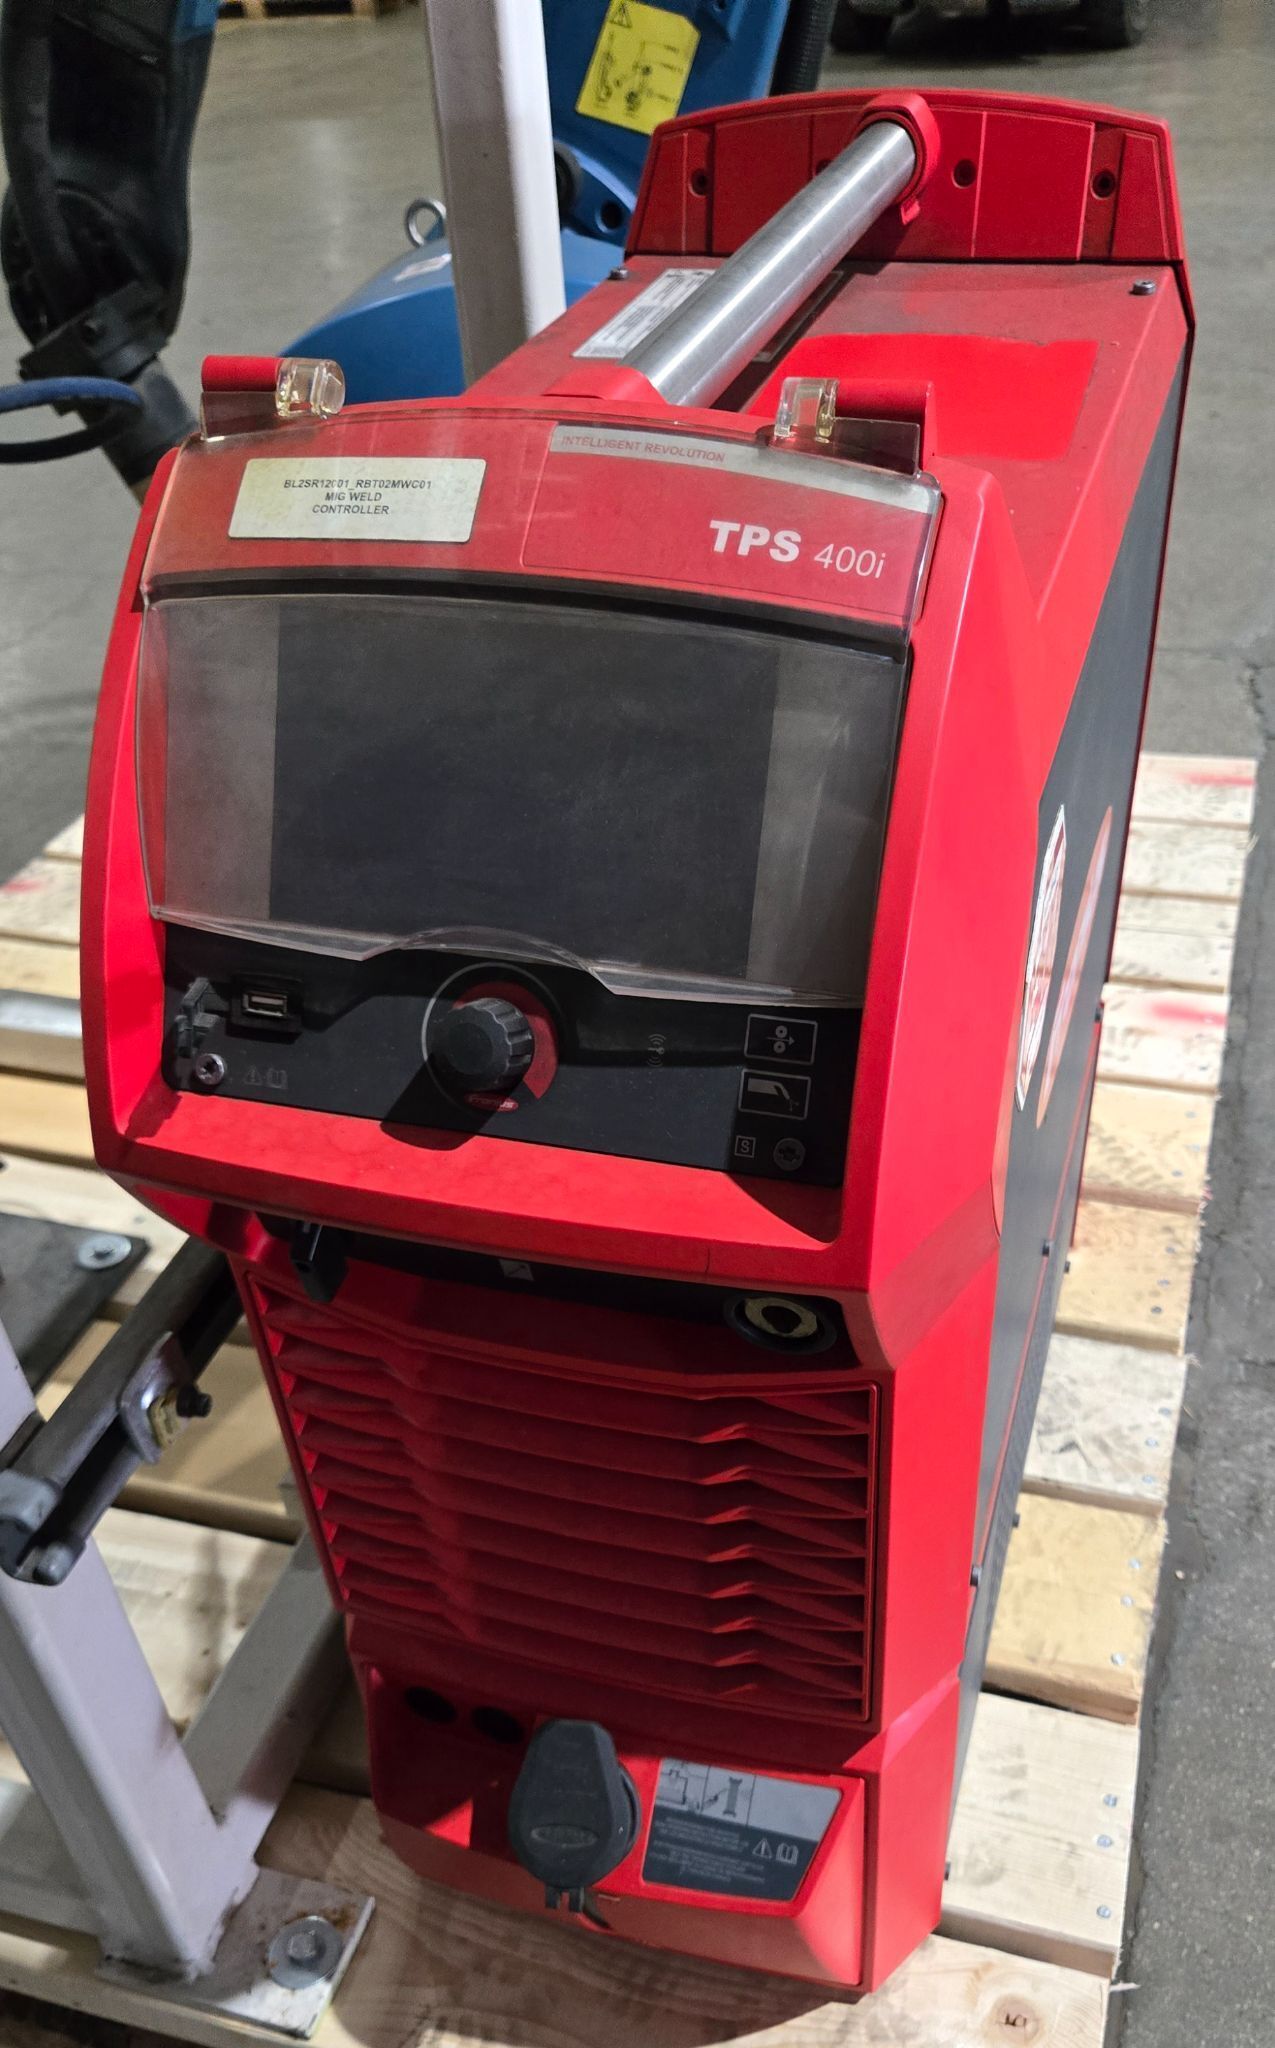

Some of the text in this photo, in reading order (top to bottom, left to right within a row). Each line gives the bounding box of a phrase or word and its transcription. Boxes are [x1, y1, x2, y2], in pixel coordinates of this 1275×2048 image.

[561, 436, 726, 462] INTELLIGENT REVOLUTION
[325, 492, 383, 502] MIG WELD
[312, 504, 390, 515] CONTROLLER
[710, 520, 887, 579] TPS 400i
[740, 1139, 751, 1153] S
